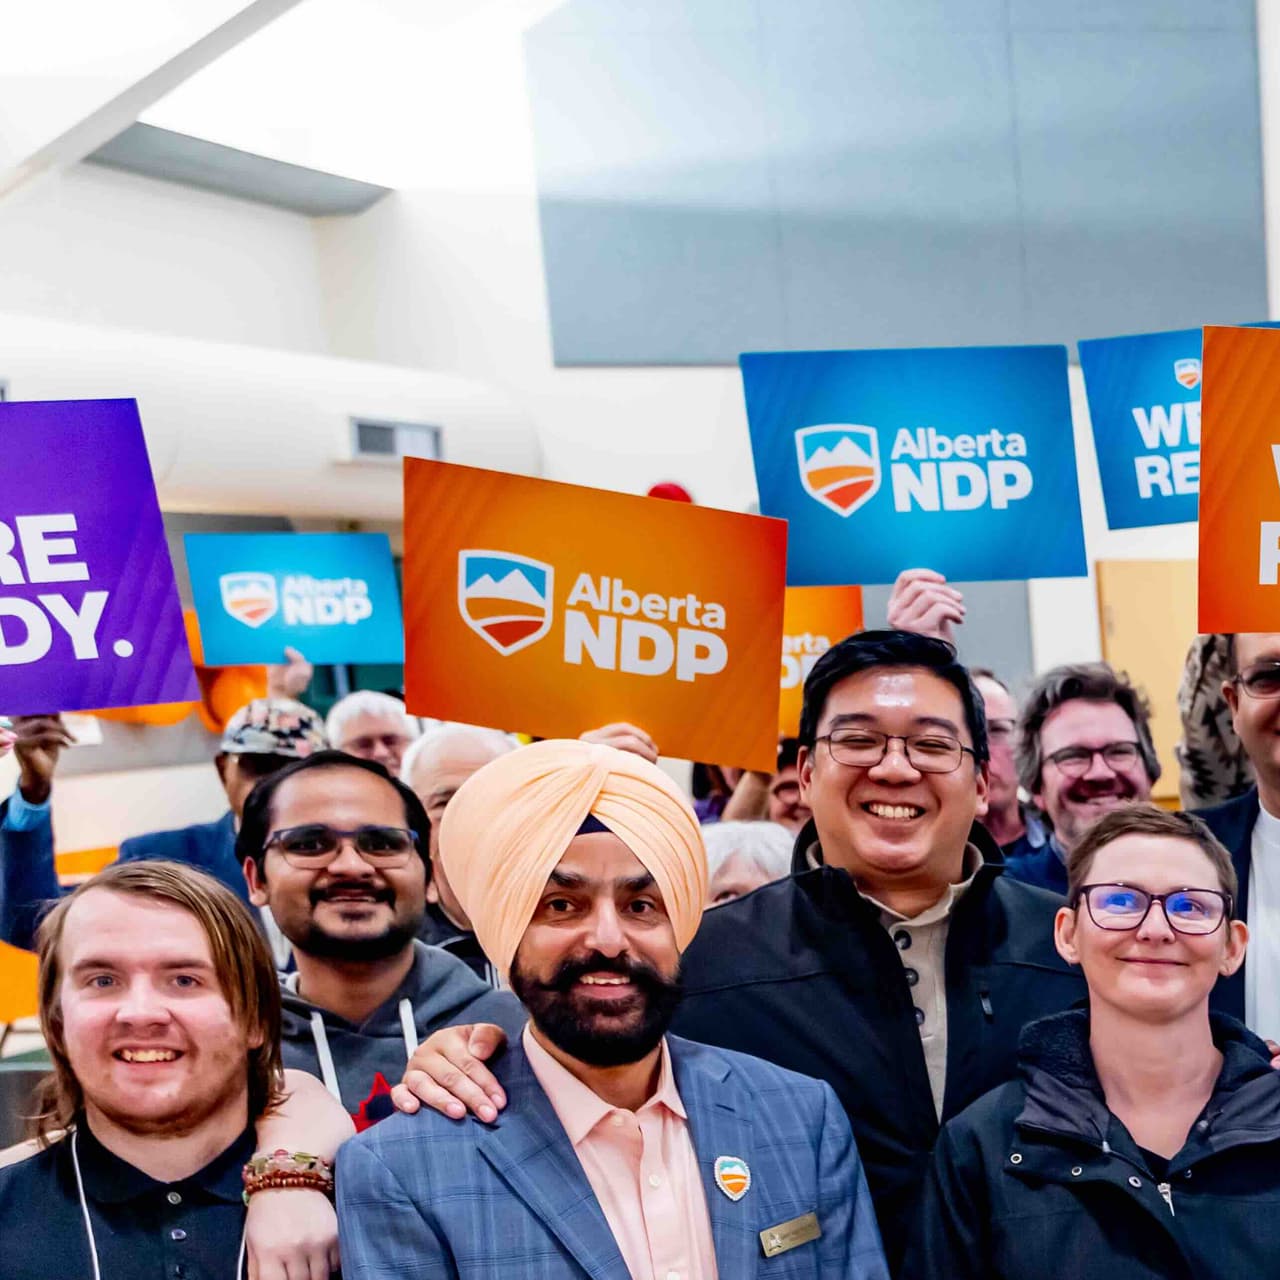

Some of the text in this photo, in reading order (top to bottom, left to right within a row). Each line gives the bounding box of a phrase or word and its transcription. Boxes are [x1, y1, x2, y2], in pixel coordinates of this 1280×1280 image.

[891, 427, 1026, 460] Alberta
[891, 460, 1033, 512] NDP
[1133, 450, 1199, 499] RE
[282, 576, 368, 597] Alberta
[283, 594, 372, 625] NDP
[567, 573, 725, 629] Alberta
[0, 591, 134, 666] DY.
[564, 610, 728, 681] NDP
